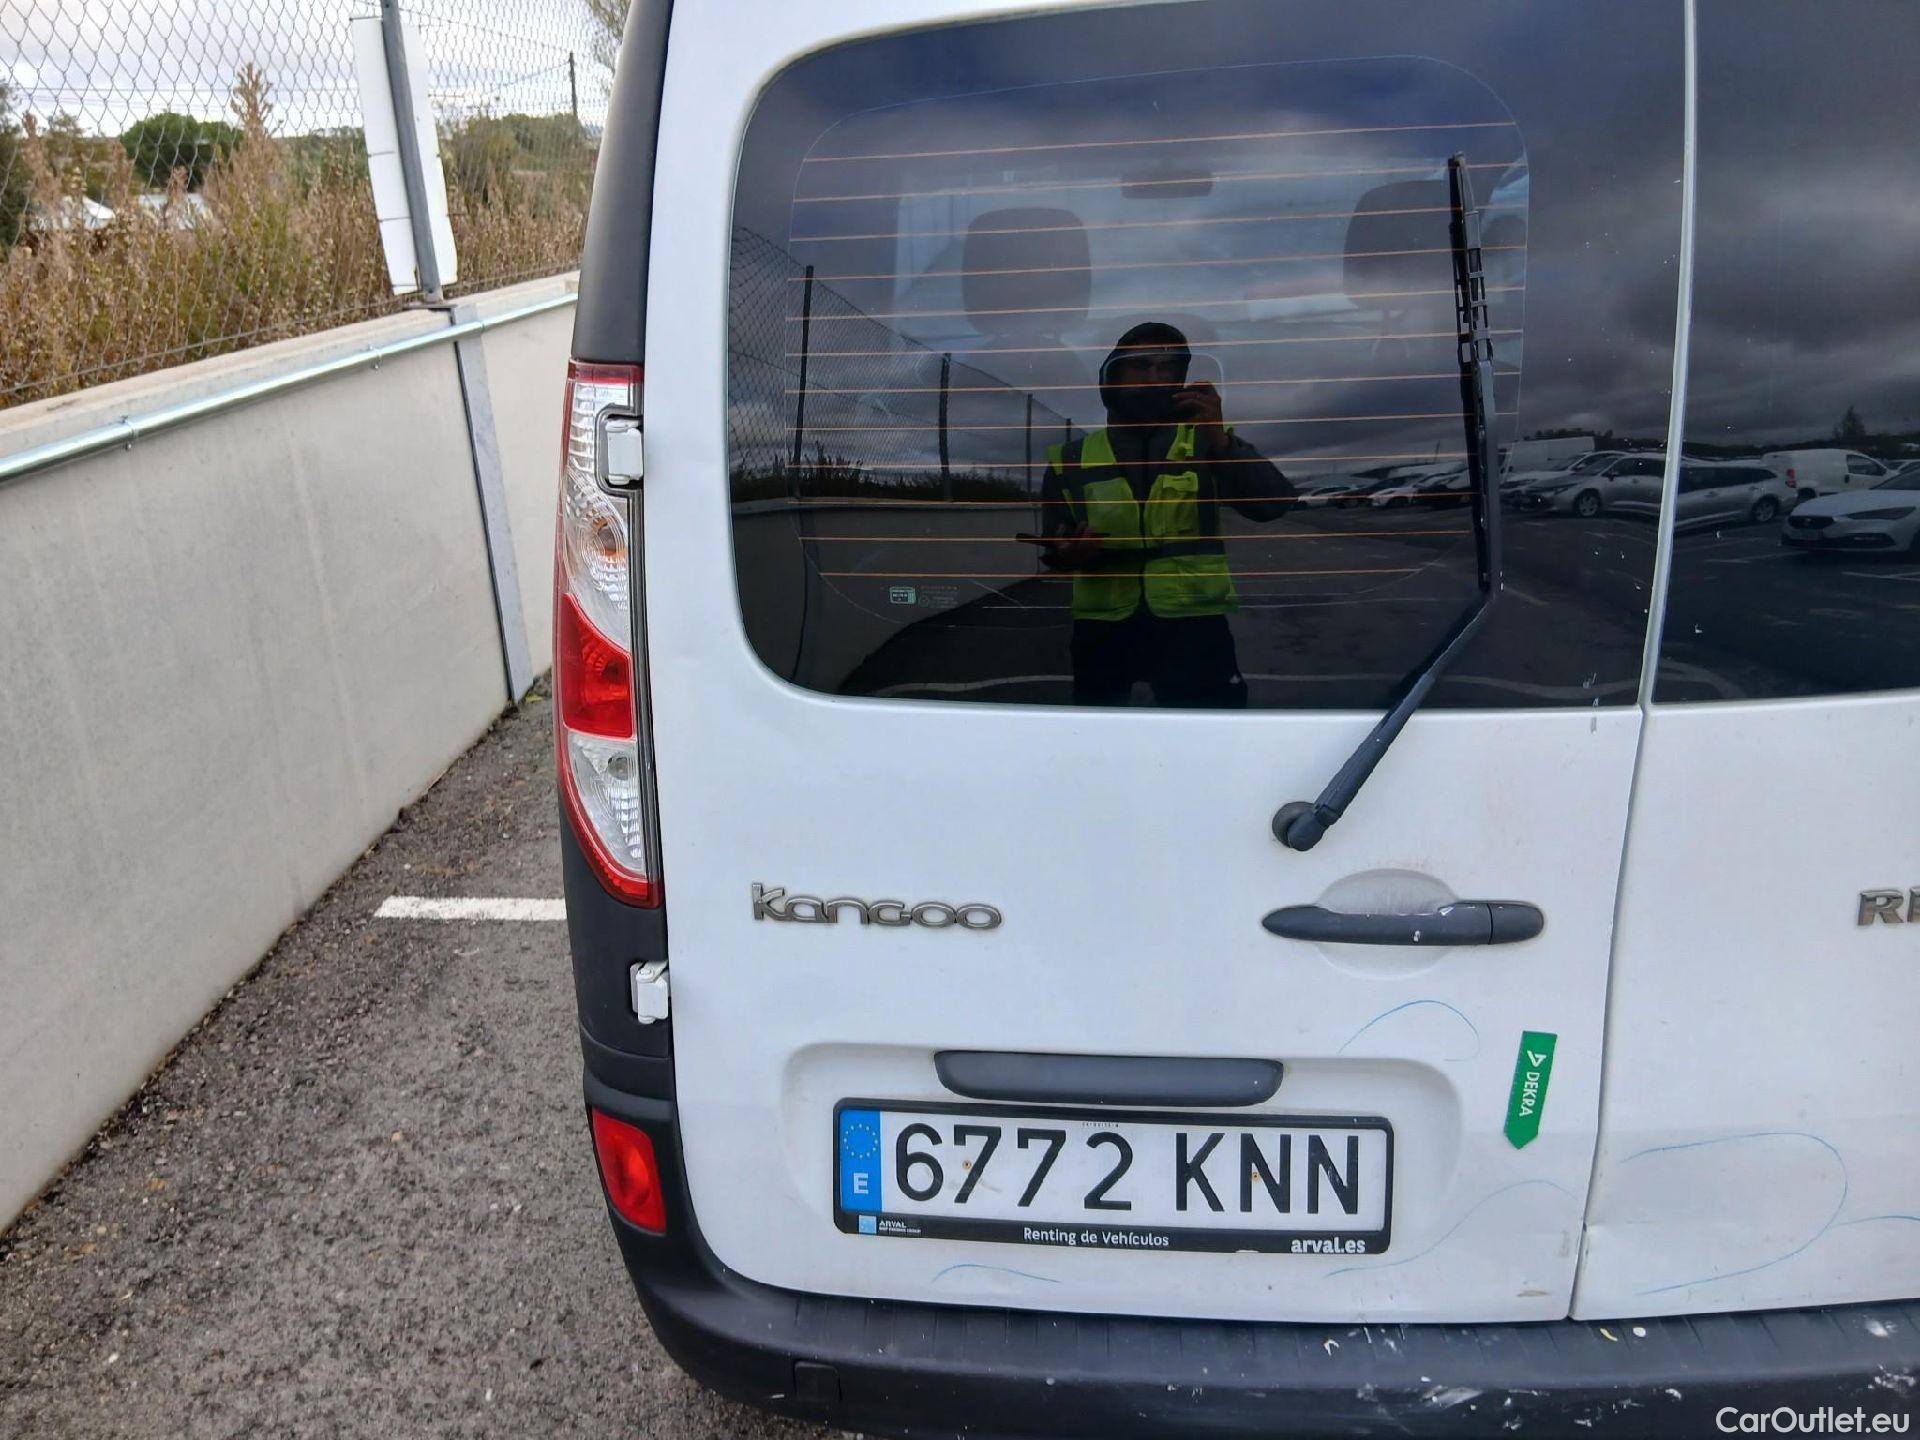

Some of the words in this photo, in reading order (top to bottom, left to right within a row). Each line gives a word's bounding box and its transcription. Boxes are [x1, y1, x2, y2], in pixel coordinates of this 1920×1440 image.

[1519, 1071, 1541, 1117] DEKRA
[895, 1122, 1133, 1211] 6772
[1175, 1132, 1359, 1215] KNN
[852, 1172, 869, 1195] E
[879, 1219, 907, 1228] ARVAL
[1023, 1227, 1076, 1246] Renting
[1080, 1230, 1098, 1244] de
[1101, 1231, 1169, 1246] Vehículos
[1290, 1236, 1366, 1254] arval.es
